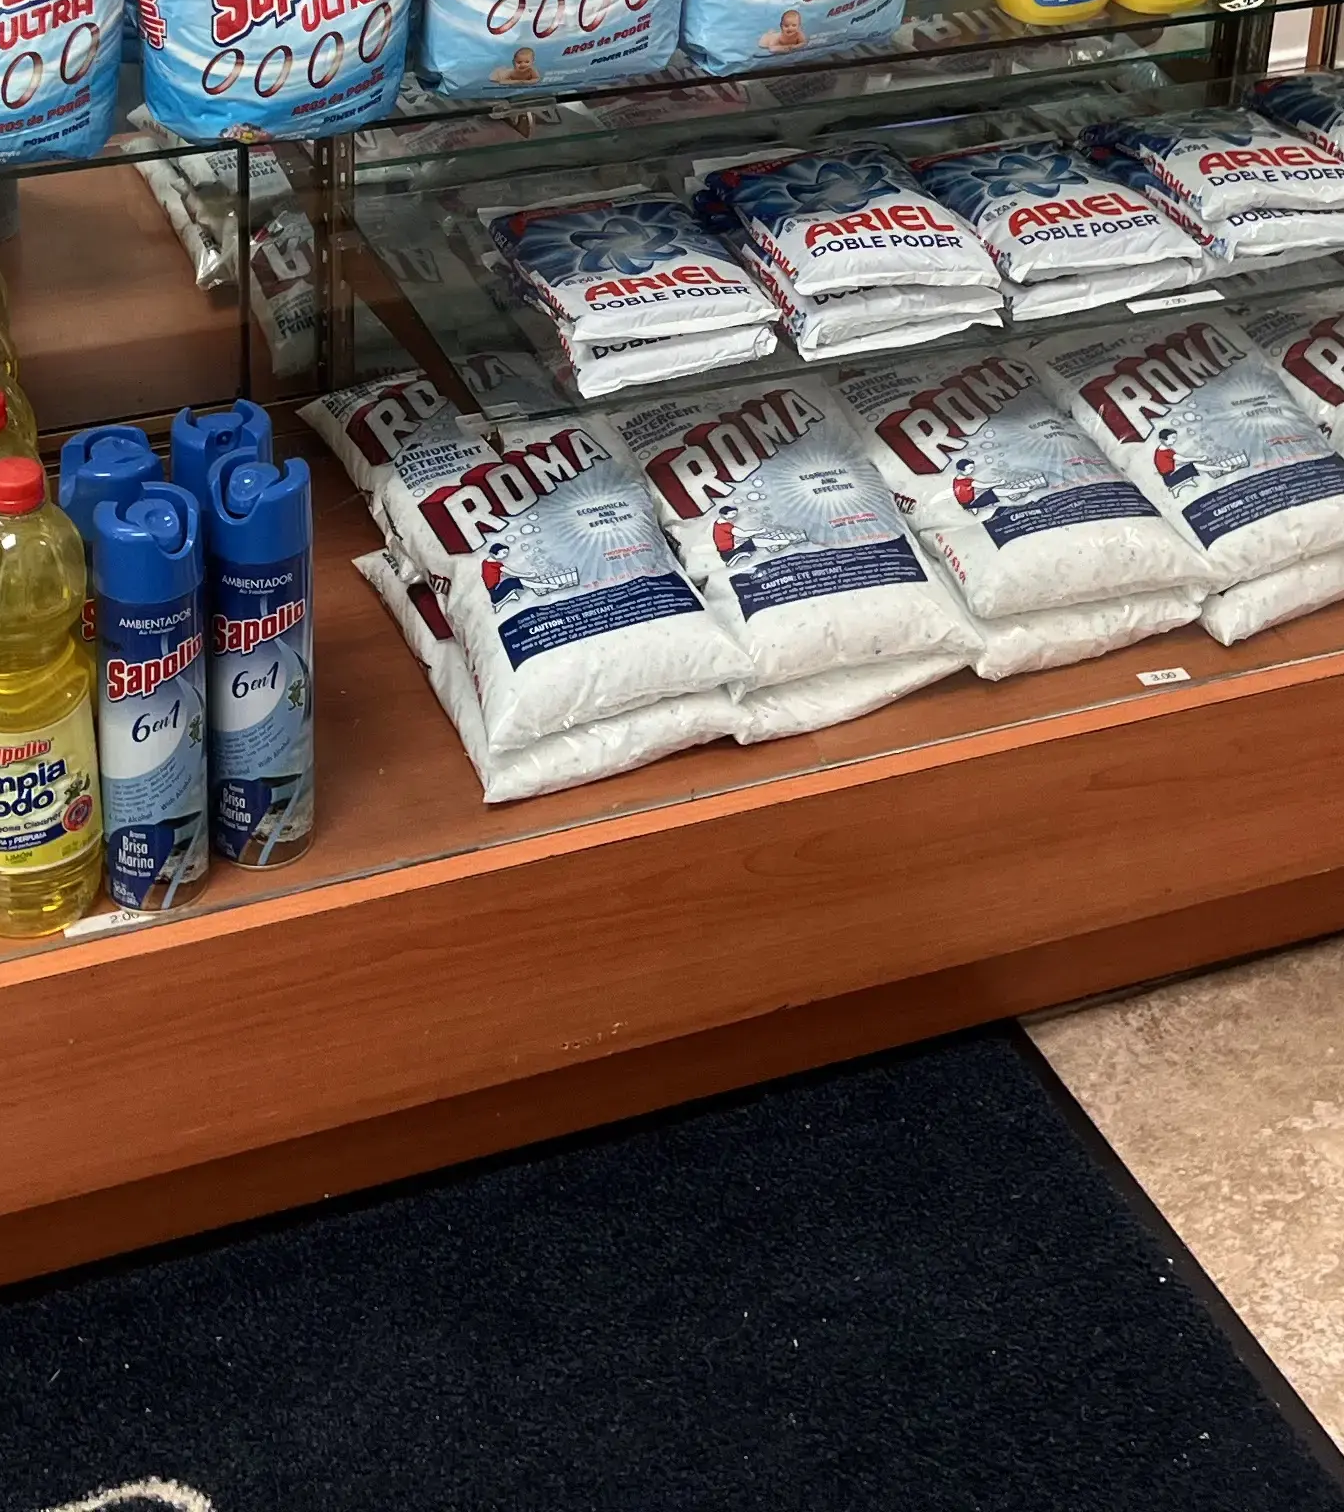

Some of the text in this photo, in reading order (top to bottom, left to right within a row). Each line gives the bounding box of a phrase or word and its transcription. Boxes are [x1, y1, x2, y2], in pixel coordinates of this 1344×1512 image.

[1198, 145, 1343, 175] ARIEL
[1207, 170, 1278, 187] DOBLE
[805, 205, 955, 249] ARIEL
[1009, 193, 1149, 238] ARIEL
[1017, 214, 1161, 246] DOBLE PODER
[811, 234, 963, 258] DOBLE PODER
[584, 265, 742, 303] ARIEL
[589, 285, 751, 312] DOBLE PODER
[1079, 322, 1248, 443] ROMA
[622, 405, 701, 440] DETERGENT
[875, 356, 1041, 476] ROMA
[395, 442, 458, 468] LAUNDRY
[398, 445, 482, 479] DETERGENT
[645, 389, 825, 520] ROMA
[418, 428, 612, 555] ROMA
[812, 483, 854, 495] EFFECTIVE
[576, 501, 629, 517] ECONOMICAL
[589, 513, 633, 528] EFFECTIVE
[598, 510, 616, 518] AND
[222, 572, 293, 590] AMBIENTADOR
[118, 607, 192, 630] AMBIENTADOR
[213, 598, 306, 657] Sapolio
[566, 614, 581, 624] EYE
[107, 631, 204, 702] Sapolio
[222, 787, 246, 809] Brisa
[23, 811, 63, 830] Cleaner
[122, 835, 148, 854] Brisa
[118, 849, 154, 869] Marina
